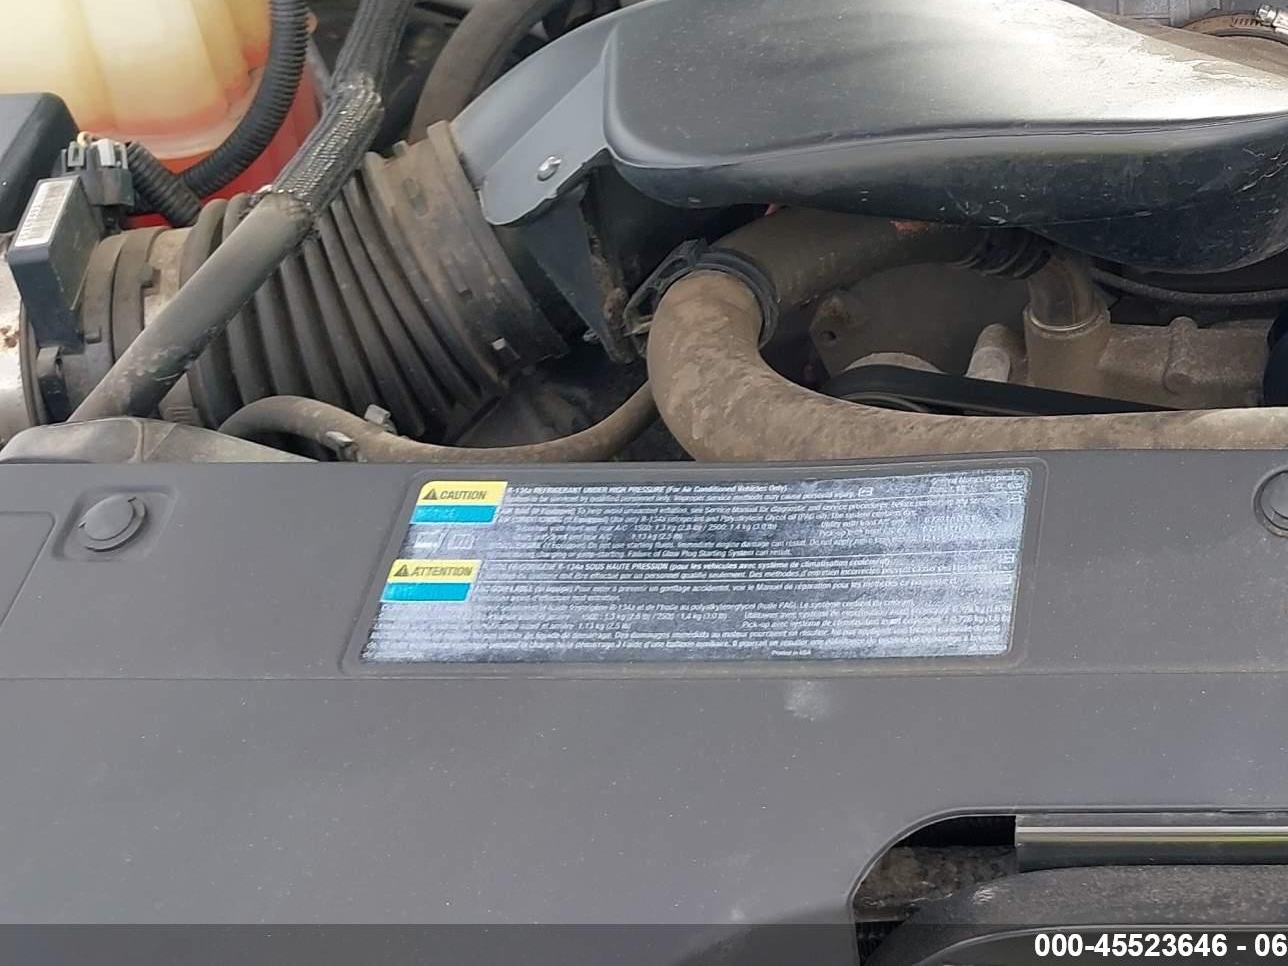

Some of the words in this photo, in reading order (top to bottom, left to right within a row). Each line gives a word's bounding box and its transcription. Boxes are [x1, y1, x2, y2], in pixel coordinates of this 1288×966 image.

[532, 486, 582, 494] REFRIGERANT
[582, 486, 608, 494] UNDER
[608, 486, 626, 494] HIGH
[626, 486, 666, 494] PRESSURE
[694, 485, 736, 494] Conditioned
[736, 484, 768, 493] Vehicles
[440, 490, 487, 500] CAUTION
[764, 493, 778, 502] may
[802, 491, 832, 501] personal
[682, 550, 698, 559] Plug
[698, 550, 726, 558] Starting
[728, 549, 754, 558] System
[410, 566, 473, 576] ATTENTION
